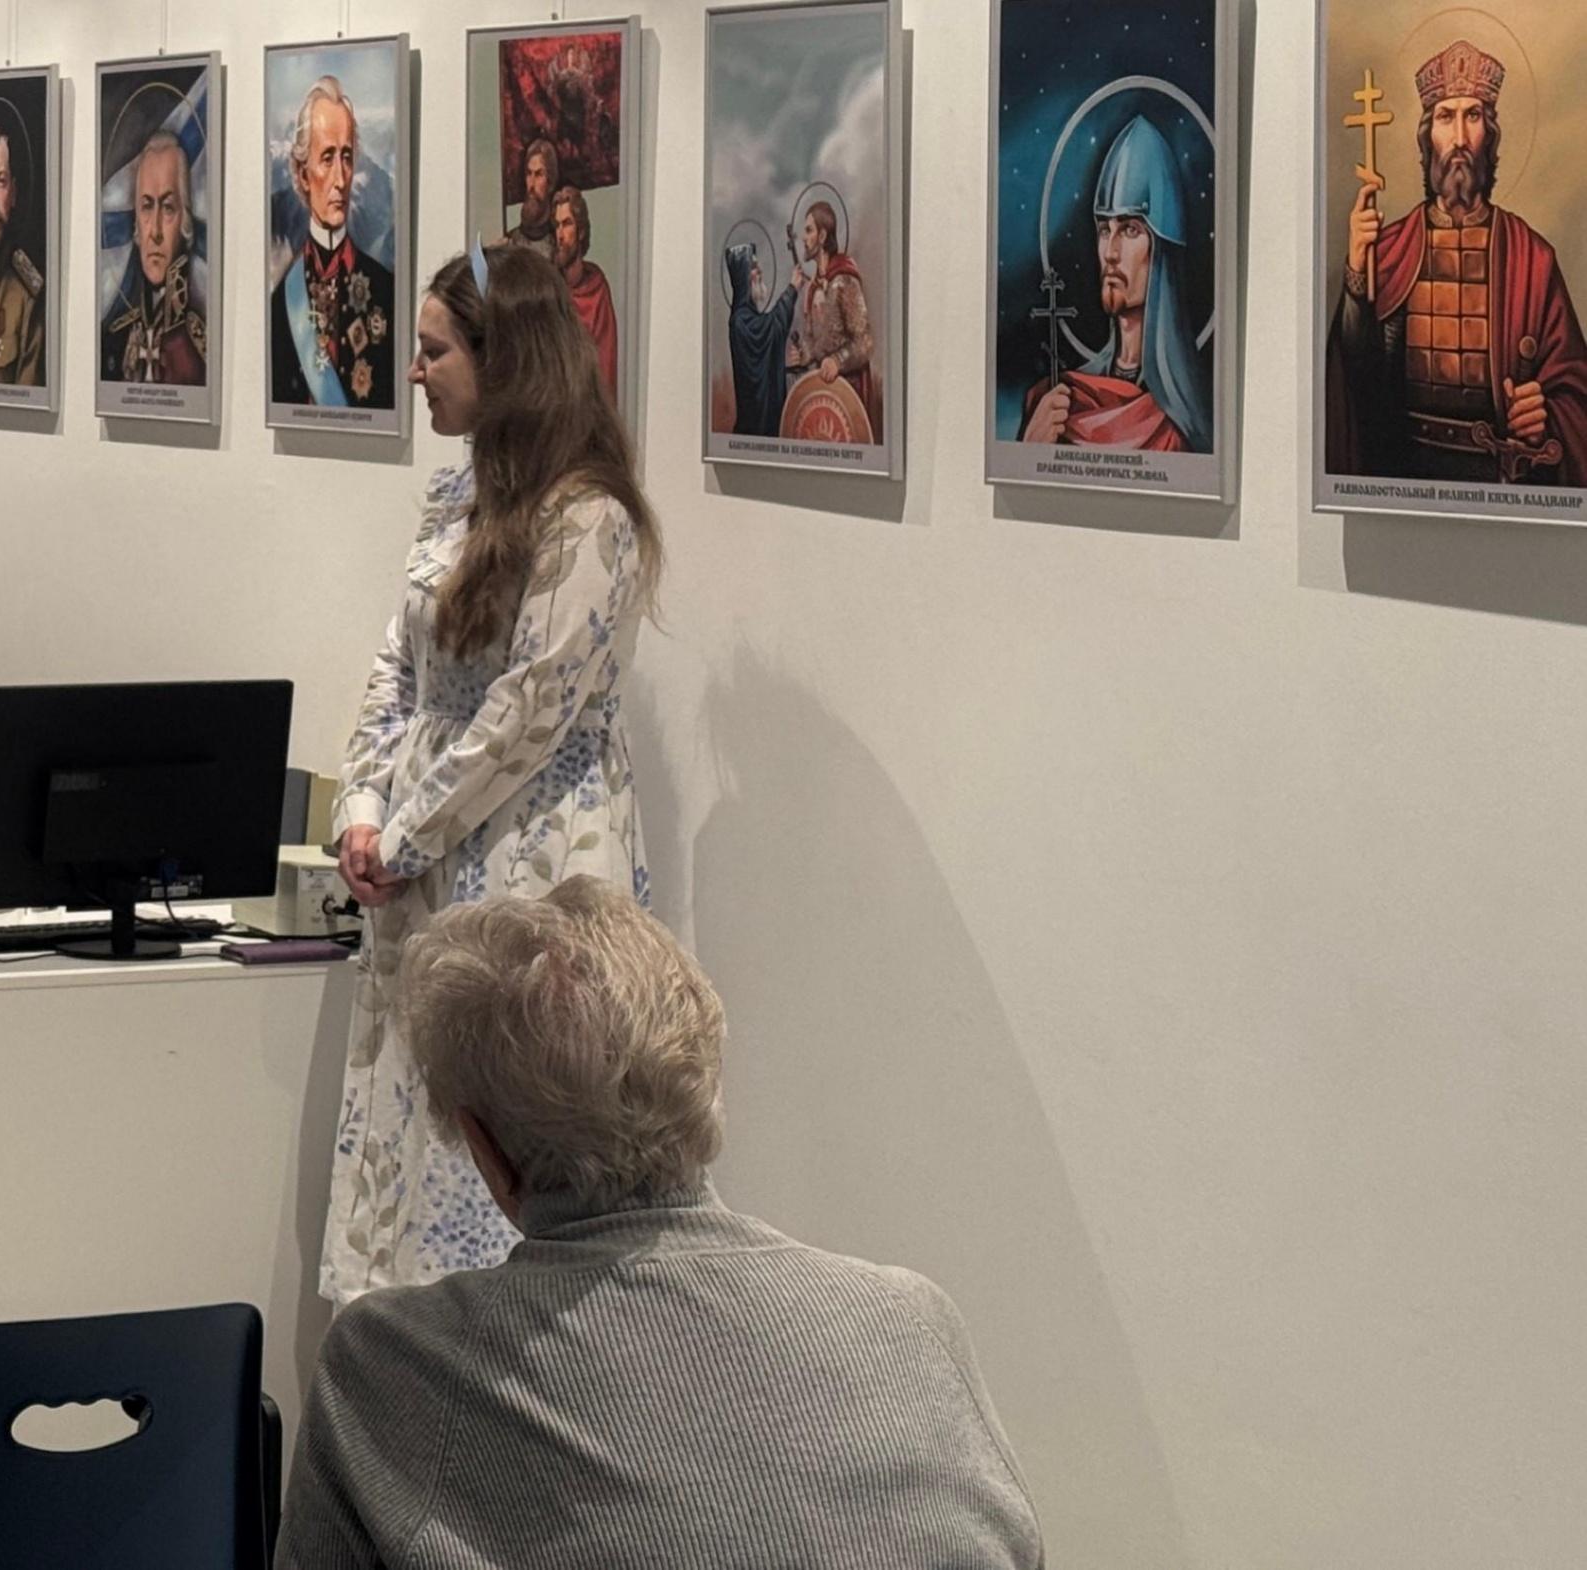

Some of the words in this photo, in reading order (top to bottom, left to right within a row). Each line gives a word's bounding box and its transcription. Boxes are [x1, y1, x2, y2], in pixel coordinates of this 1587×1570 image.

[1333, 482, 1436, 500] РАВНОАПОСТОЛЬНЫЙ
[1438, 489, 1485, 503] ВЕЛИКИЙ
[1487, 492, 1522, 505] КНЯЗЬ
[1523, 494, 1583, 509] ВЛАДИМИР
